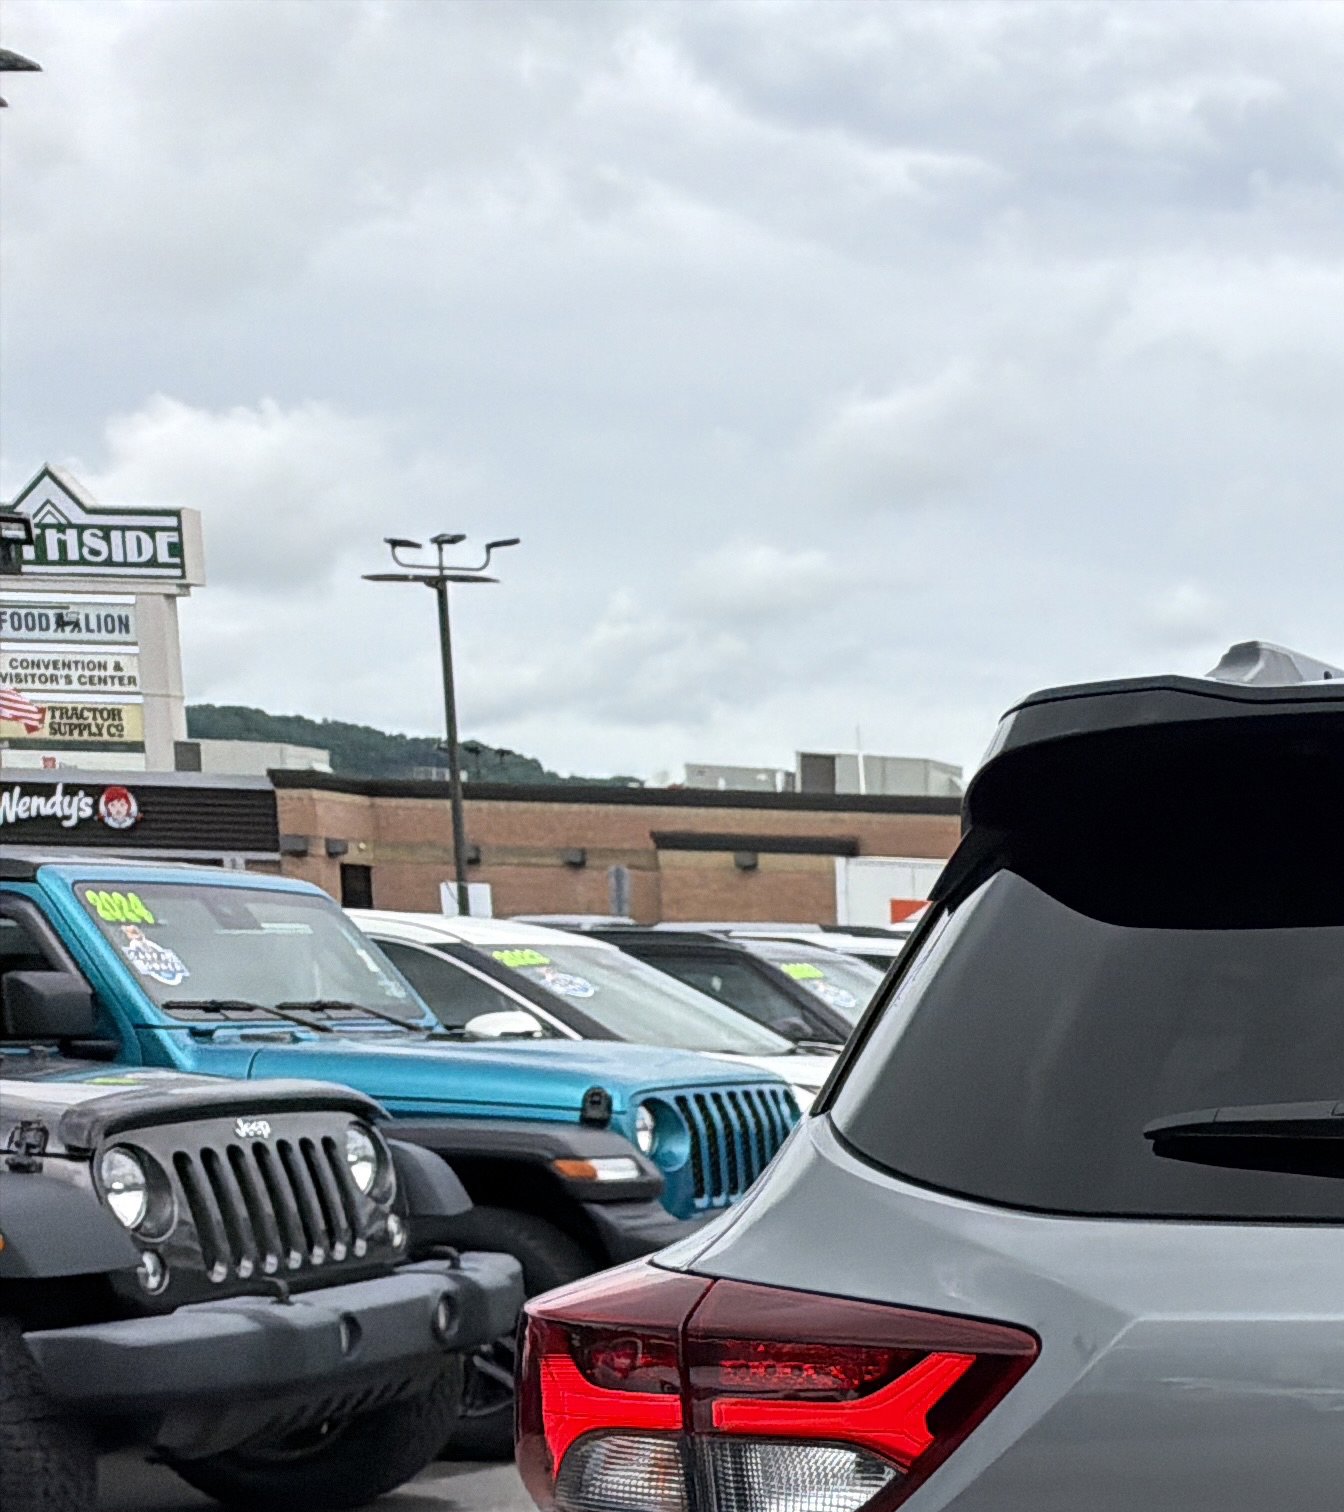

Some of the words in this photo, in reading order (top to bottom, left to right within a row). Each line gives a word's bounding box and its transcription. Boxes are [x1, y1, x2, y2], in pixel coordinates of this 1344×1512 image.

[0, 611, 50, 632] FOOD
[84, 612, 130, 635] LION
[8, 657, 108, 672] CONVENTION
[113, 660, 124, 673] &
[0, 671, 73, 686] VISITOR'S
[77, 673, 138, 688] CENTER
[47, 705, 123, 722] TRACTOR
[48, 721, 104, 738] SUPPLY
[0, 782, 94, 828] Wendy's
[85, 890, 154, 923] 2024
